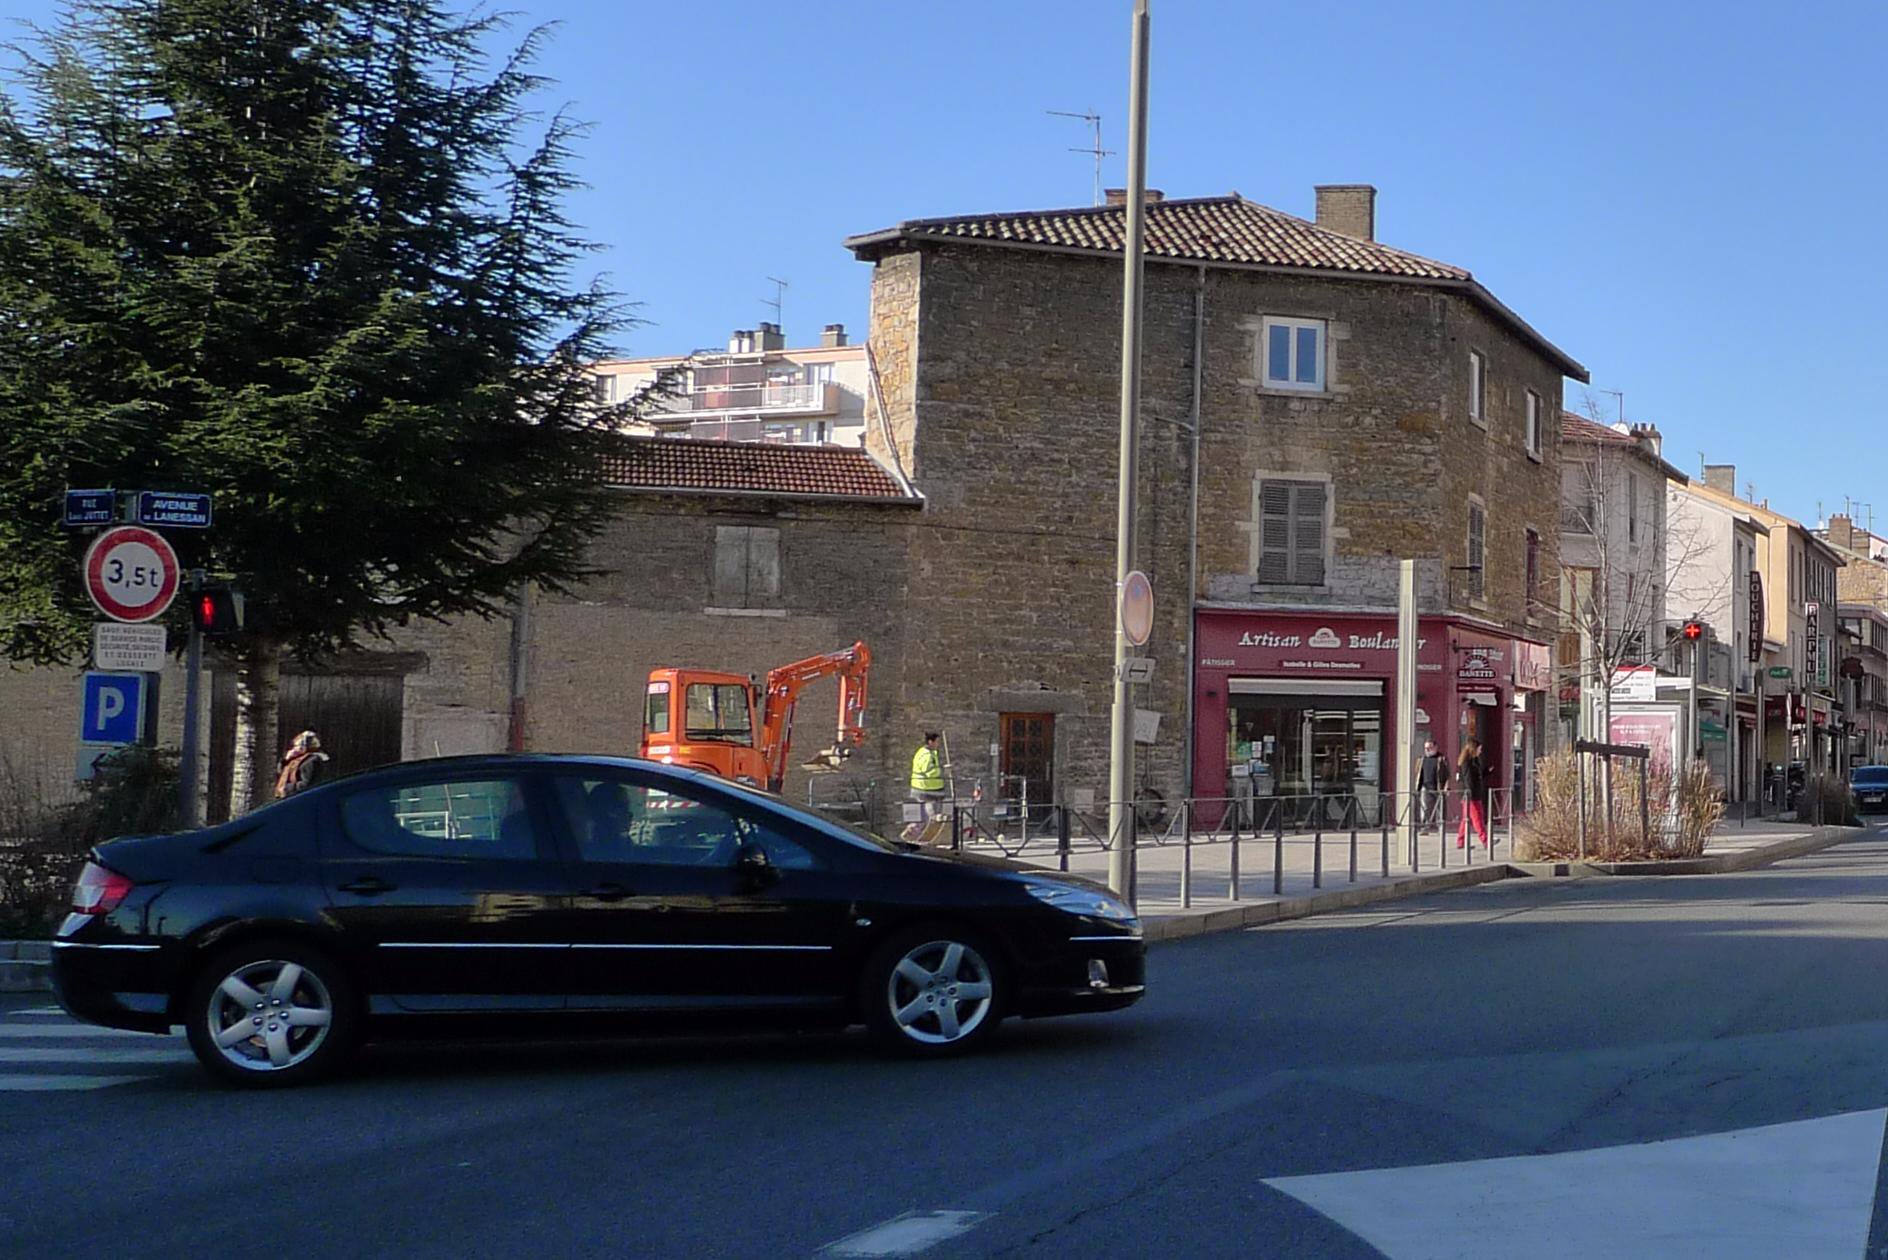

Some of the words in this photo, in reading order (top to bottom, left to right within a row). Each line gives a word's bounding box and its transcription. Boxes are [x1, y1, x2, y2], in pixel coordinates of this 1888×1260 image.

[153, 499, 198, 511] AVENUE
[154, 511, 206, 523] LANESSAN
[1750, 572, 1761, 661] BOUCHERIE
[1808, 604, 1817, 636] BAR
[1238, 631, 1301, 648] Artisan
[1349, 632, 1427, 650] Boulanr
[1459, 669, 1495, 678] BANETTE
[96, 686, 125, 731] P
